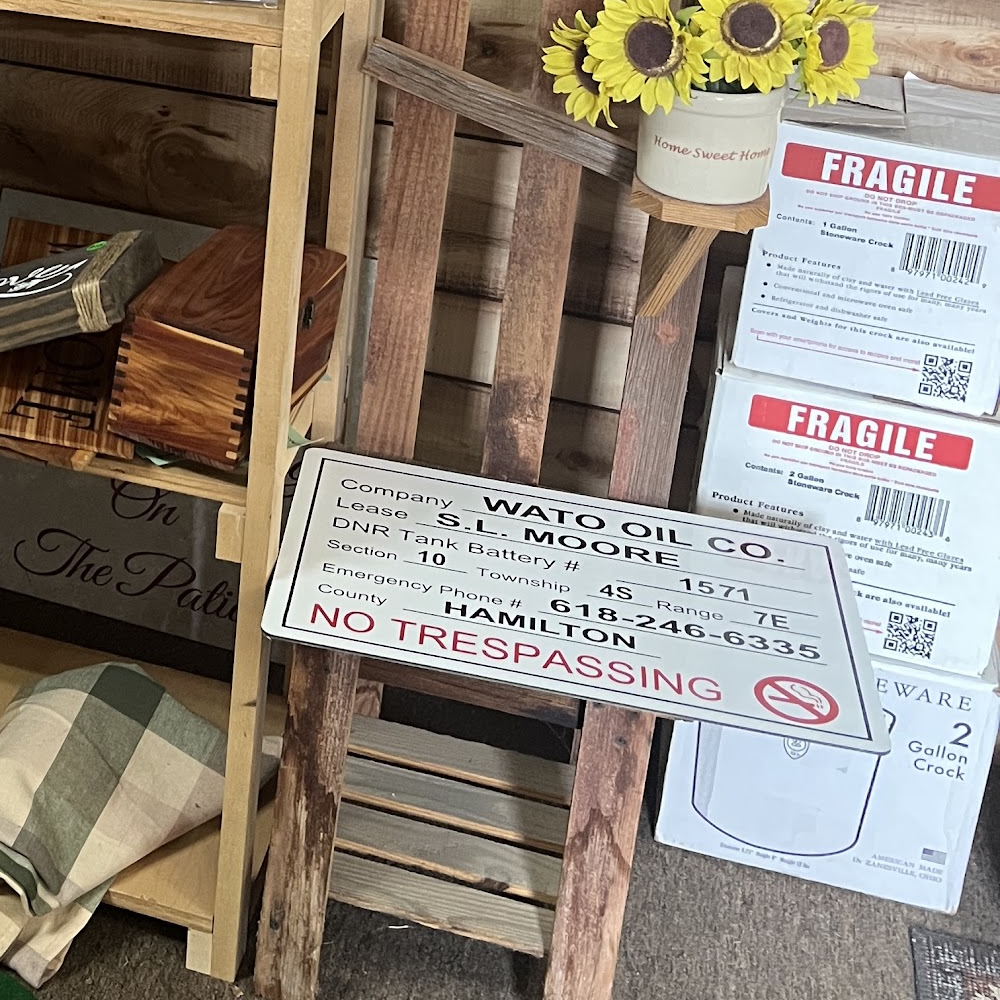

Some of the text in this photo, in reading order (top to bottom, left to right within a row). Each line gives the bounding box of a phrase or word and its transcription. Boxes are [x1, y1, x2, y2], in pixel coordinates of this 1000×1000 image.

[653, 134, 692, 155] Home
[692, 147, 738, 161] Sweet
[821, 151, 977, 205] FRAGILE
[896, 198, 918, 206] DROP
[776, 213, 816, 226] Contents:
[829, 223, 858, 234] Gallon
[820, 230, 894, 249] Stoneware Crock
[762, 250, 841, 270] Product Features
[822, 291, 836, 299] and
[898, 306, 913, 314] safe
[751, 307, 779, 317] Covers
[782, 313, 797, 321] and
[800, 316, 832, 327] Weights
[850, 326, 866, 334] this
[869, 330, 893, 340] crock
[912, 338, 930, 346] also
[933, 342, 975, 354] available!
[787, 404, 937, 461] FRAGILE
[745, 462, 784, 475] Contents:
[797, 473, 825, 484] Gallon
[110, 478, 180, 526] On
[712, 491, 804, 517] Product Features
[787, 479, 861, 500] Stoneware Crock
[336, 497, 681, 568] Lease S.L. MOORE
[341, 478, 785, 563] Company WATO OIL CO.
[743, 510, 764, 519] Made
[766, 515, 801, 528] naturally
[814, 525, 830, 535] clay
[832, 529, 847, 537] and
[849, 533, 872, 542] water
[874, 537, 894, 547] with
[896, 542, 915, 552] Lead
[916, 547, 934, 557] Free
[13, 528, 114, 586] The
[332, 517, 750, 602] DNR Tank Battery # 1571
[326, 539, 790, 630] Section 10 Township 4S Range 7E
[318, 583, 636, 650] County HAMILTON
[322, 562, 821, 661] Emergency Phone # 618-246-6335
[310, 603, 722, 702] NO TRESPASSING
[875, 677, 973, 712] EWARE
[949, 722, 973, 749] 2
[908, 740, 968, 765] Gallon
[913, 758, 966, 781] Crock
[865, 860, 917, 879] ZANESVILLE,
[918, 872, 943, 884] OHIO
[871, 853, 944, 876] AMERICAN MADE
